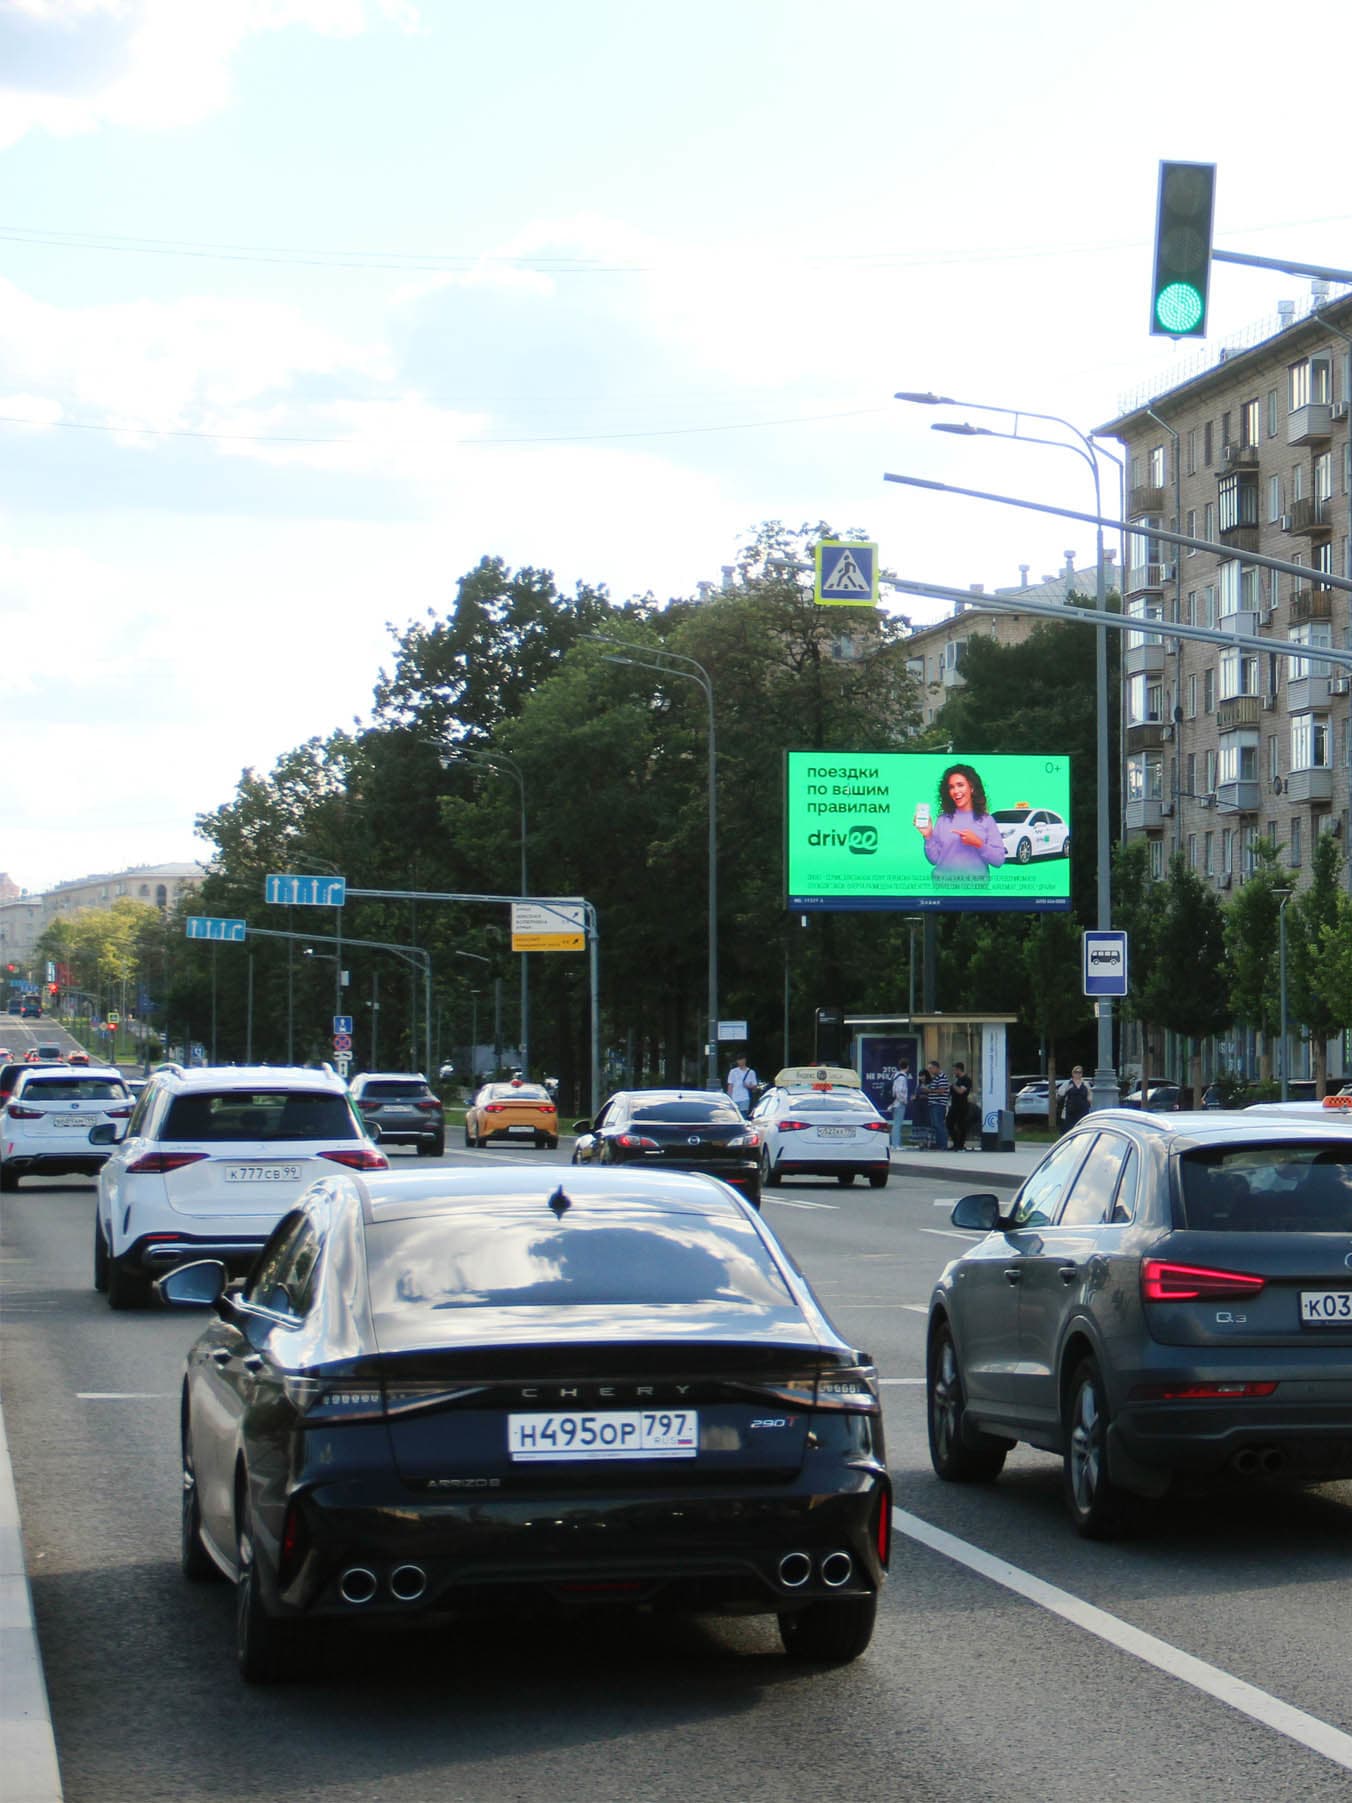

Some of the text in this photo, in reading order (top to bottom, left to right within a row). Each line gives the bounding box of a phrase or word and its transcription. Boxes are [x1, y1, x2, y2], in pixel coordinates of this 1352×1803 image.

[807, 767, 879, 779] поездки
[1044, 761, 1061, 774] 0+
[807, 785, 889, 796] по вашим
[807, 802, 890, 815] правилам
[1216, 1312, 1248, 1323] Q3
[521, 1385, 690, 1398] CHERY
[643, 1414, 687, 1436] 797
